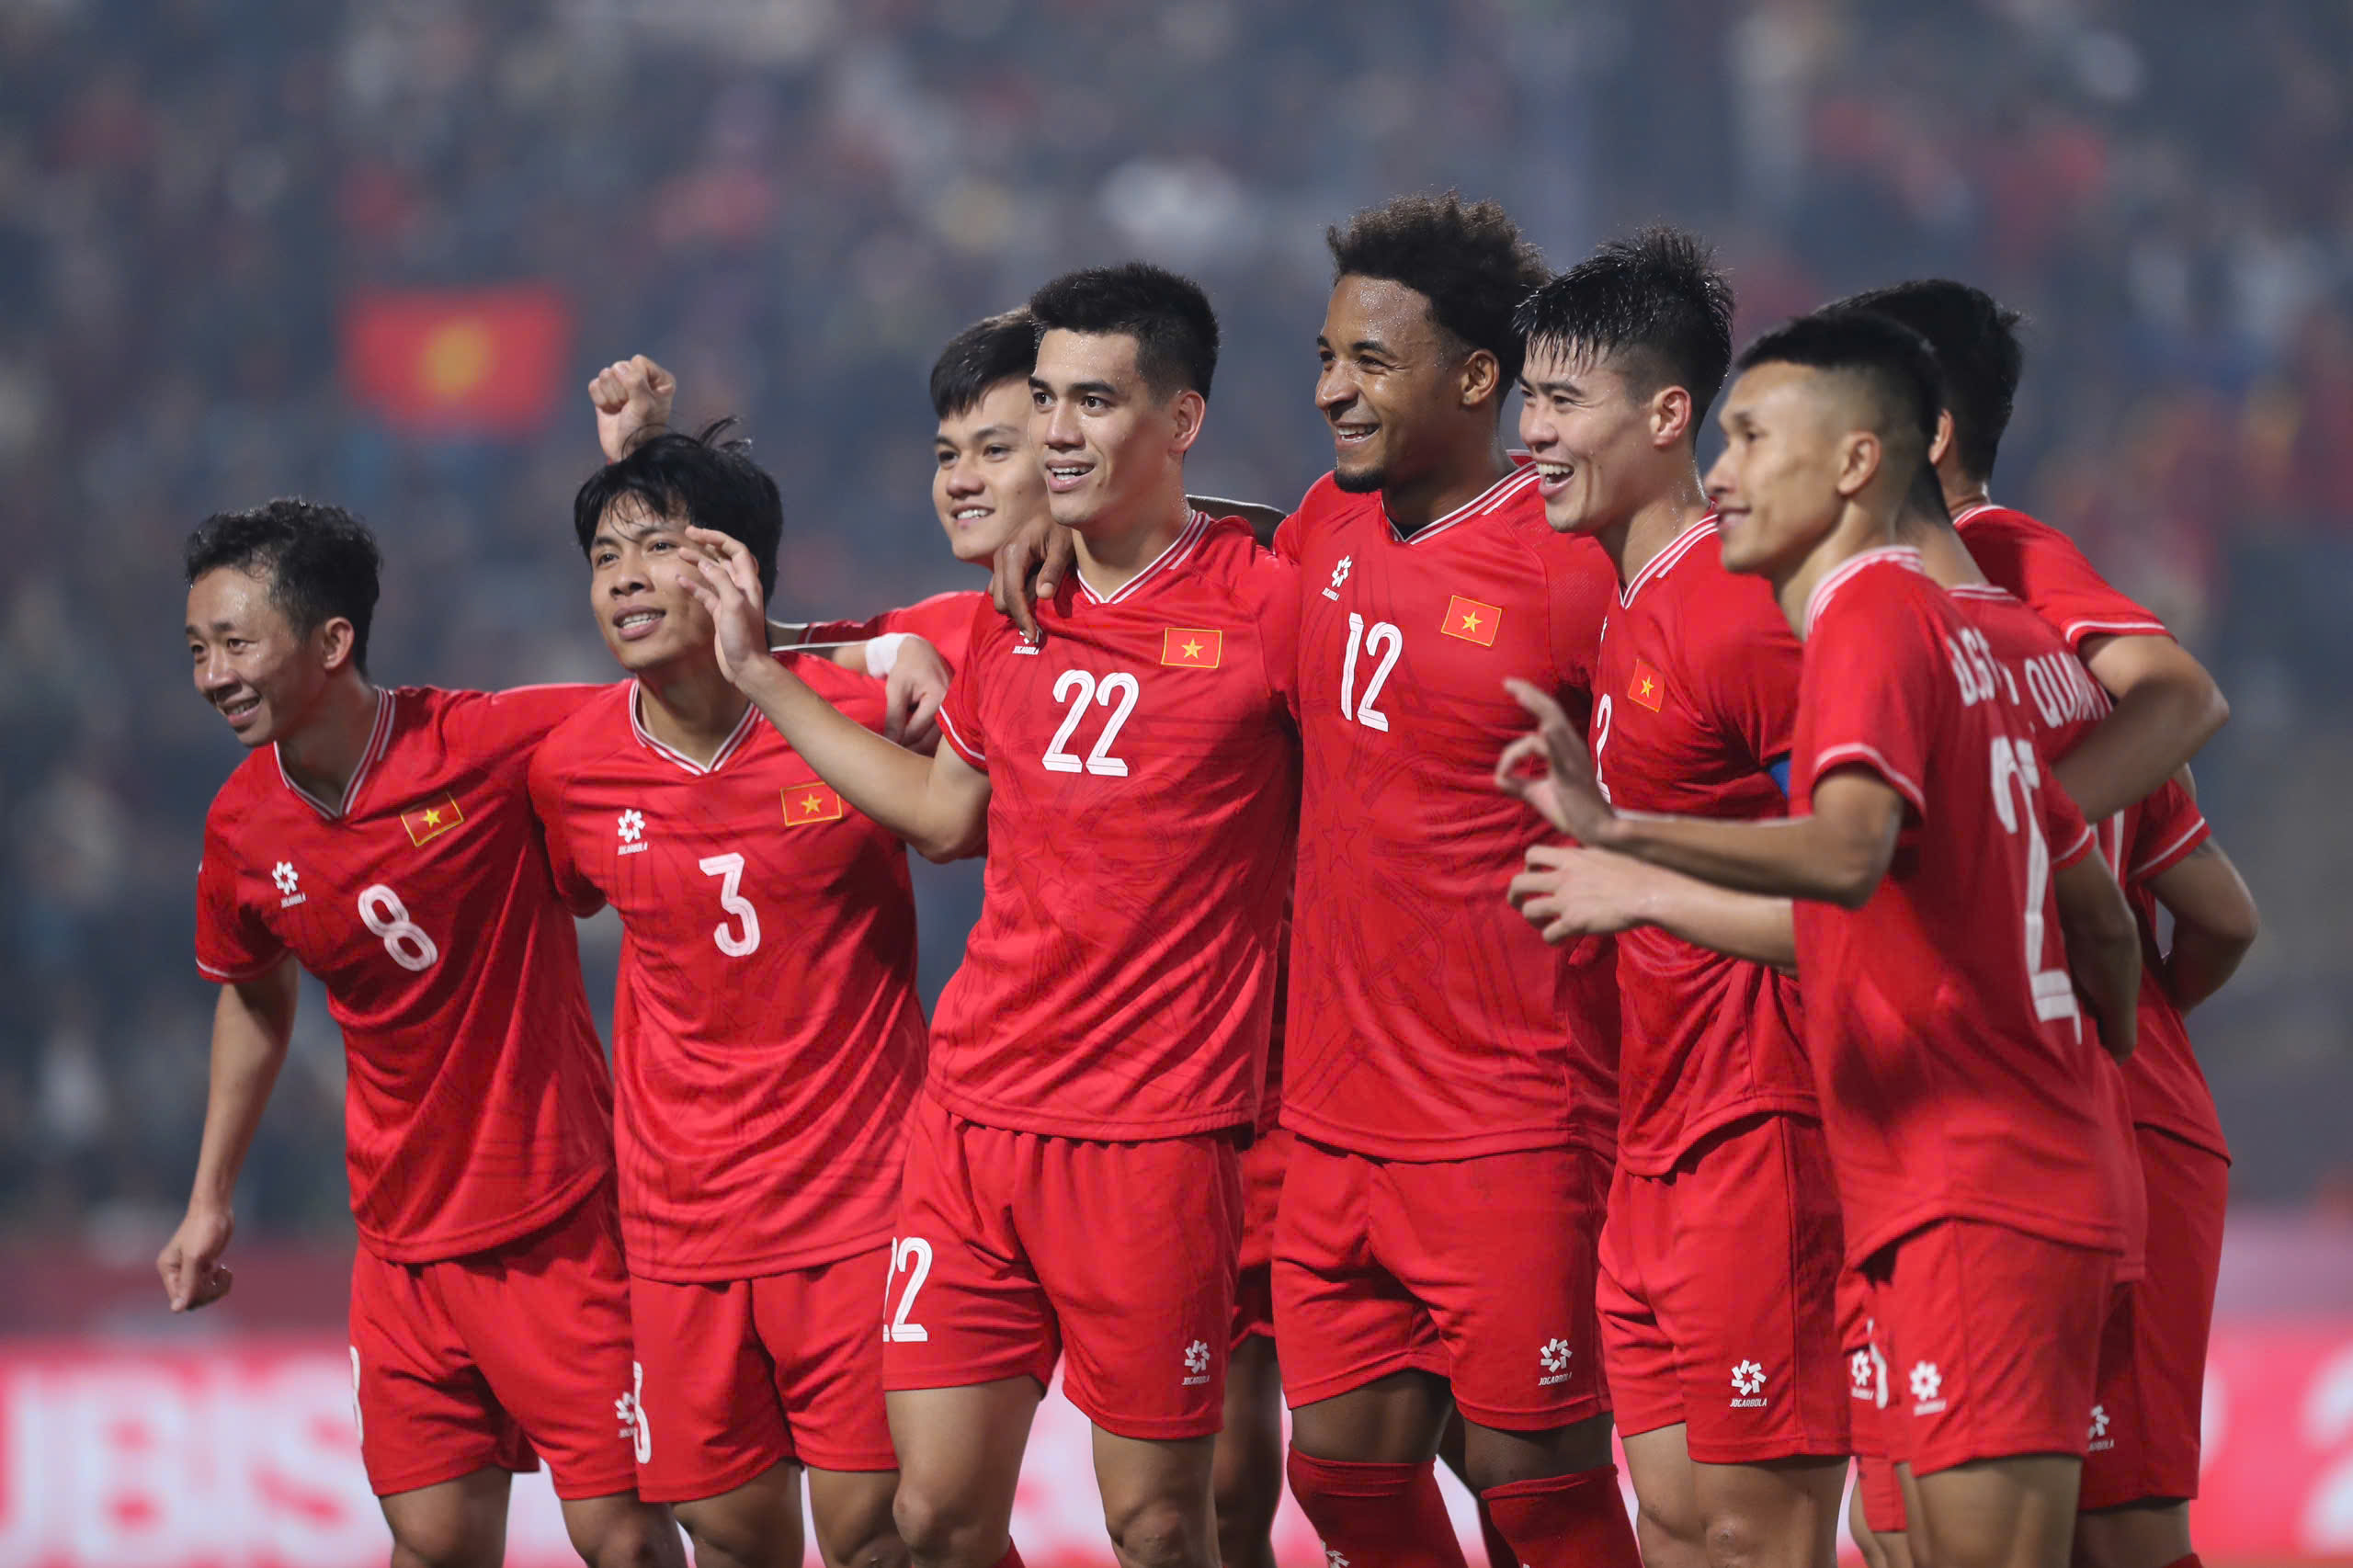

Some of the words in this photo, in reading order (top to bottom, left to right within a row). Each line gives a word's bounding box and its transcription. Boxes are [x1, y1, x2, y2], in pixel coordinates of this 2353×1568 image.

[1042, 669, 1140, 778] 22
[1340, 612, 1404, 733] 12
[358, 883, 438, 971] 8
[699, 852, 761, 957] 3
[1729, 1397, 1768, 1408] JOGARBOLA
